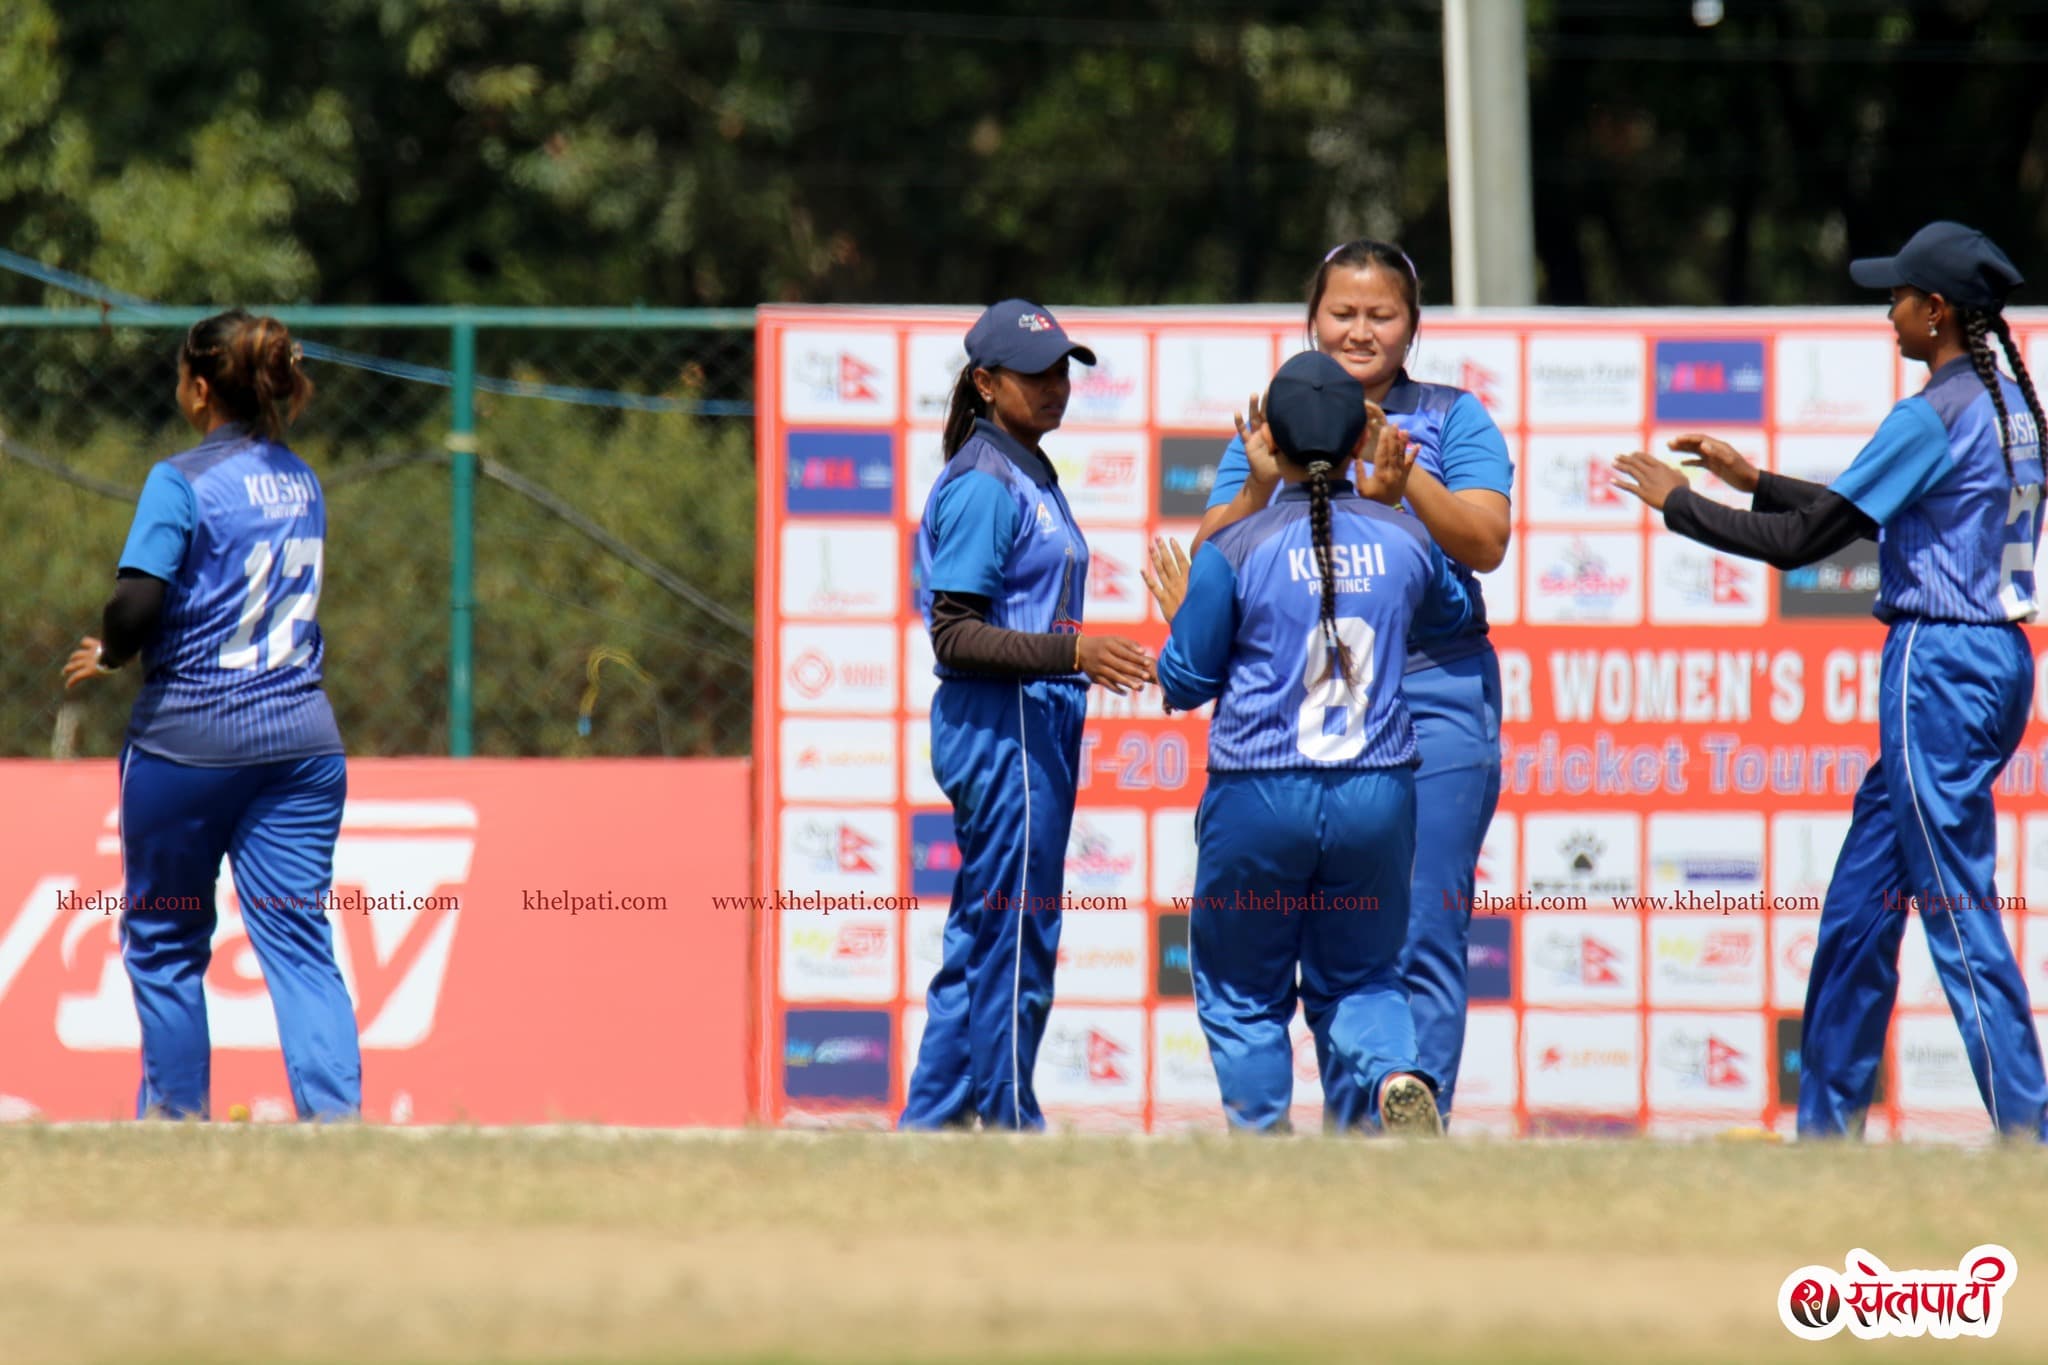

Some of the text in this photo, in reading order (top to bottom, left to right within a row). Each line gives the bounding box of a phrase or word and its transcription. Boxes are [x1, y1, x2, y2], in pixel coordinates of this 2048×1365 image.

[1992, 412, 2040, 448] OSH
[244, 471, 317, 506] KOSHI
[219, 537, 324, 671] 12
[1296, 616, 1376, 761] 8
[1550, 650, 1805, 724] WOMEN'S
[1825, 648, 1882, 724] CH
[1078, 731, 1189, 791] T-20
